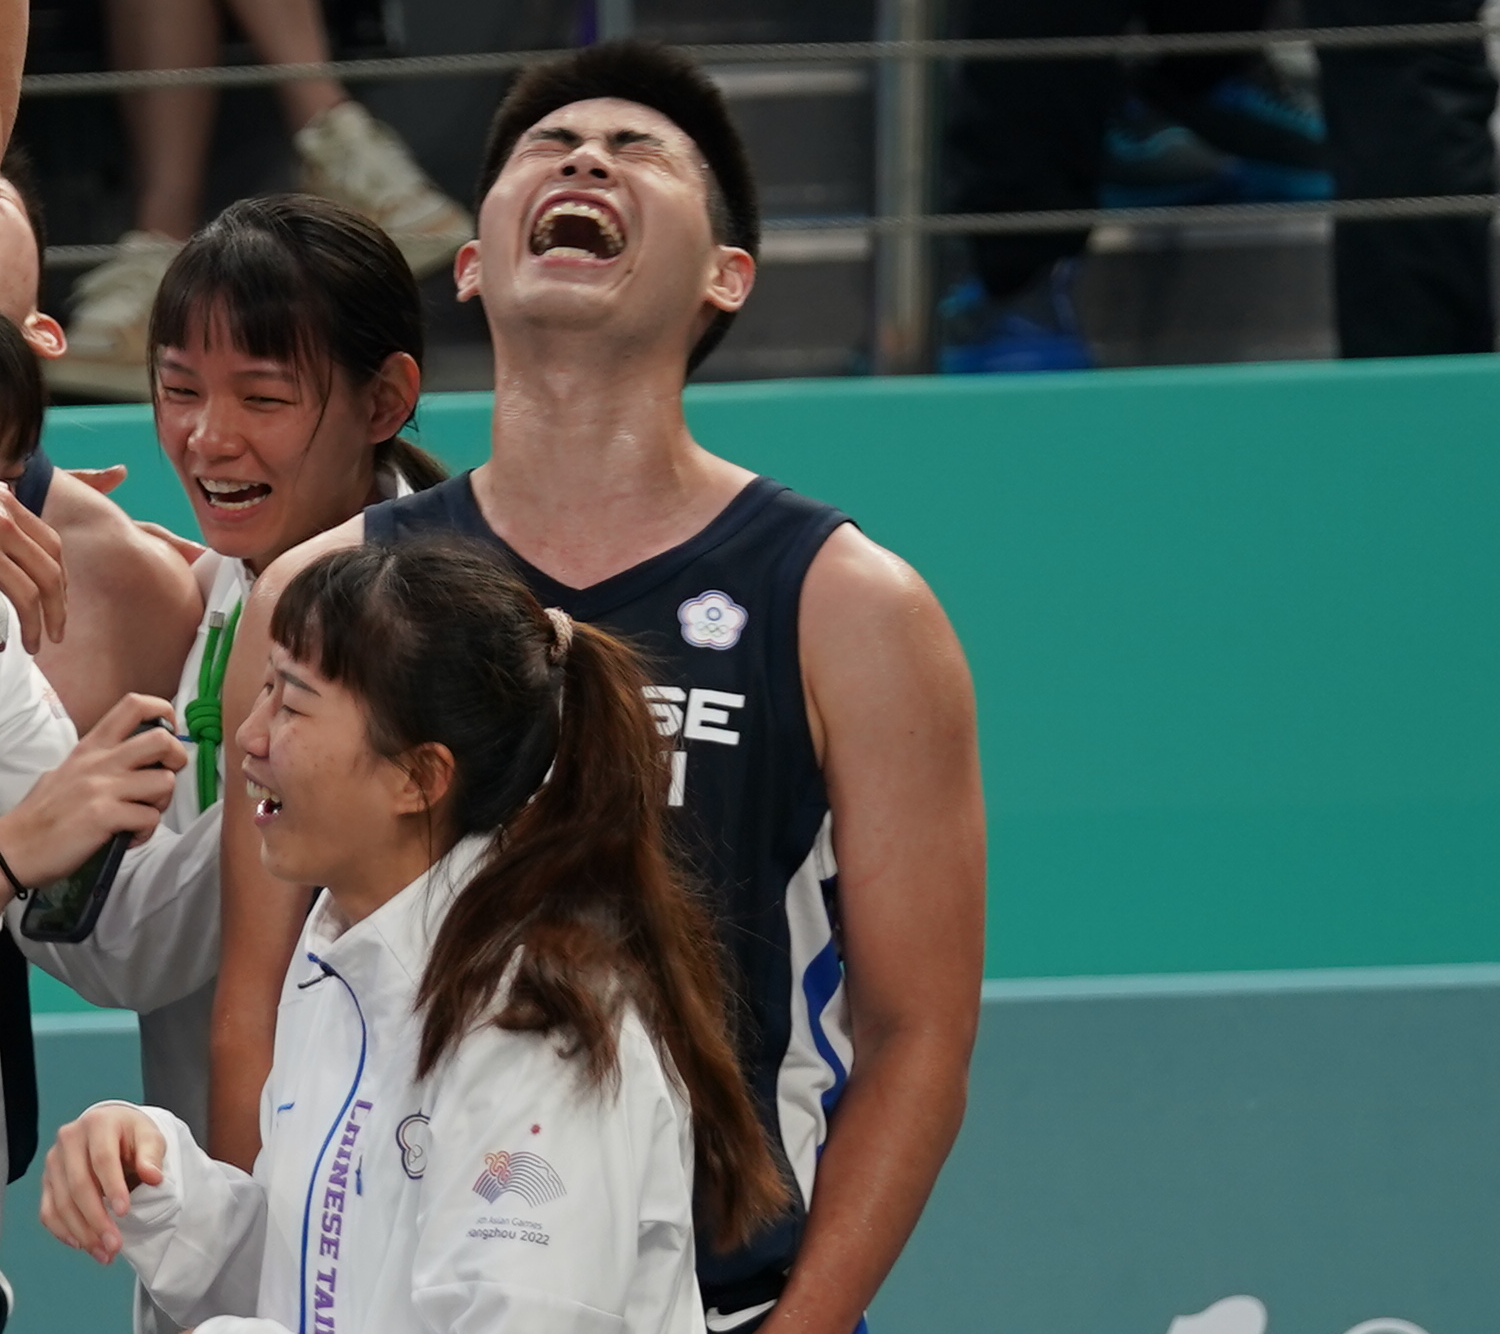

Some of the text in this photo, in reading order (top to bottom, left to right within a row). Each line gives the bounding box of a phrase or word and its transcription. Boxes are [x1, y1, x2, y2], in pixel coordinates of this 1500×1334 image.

[511, 1217, 543, 1230] Games
[466, 1227, 550, 1246] angzhou 2022
